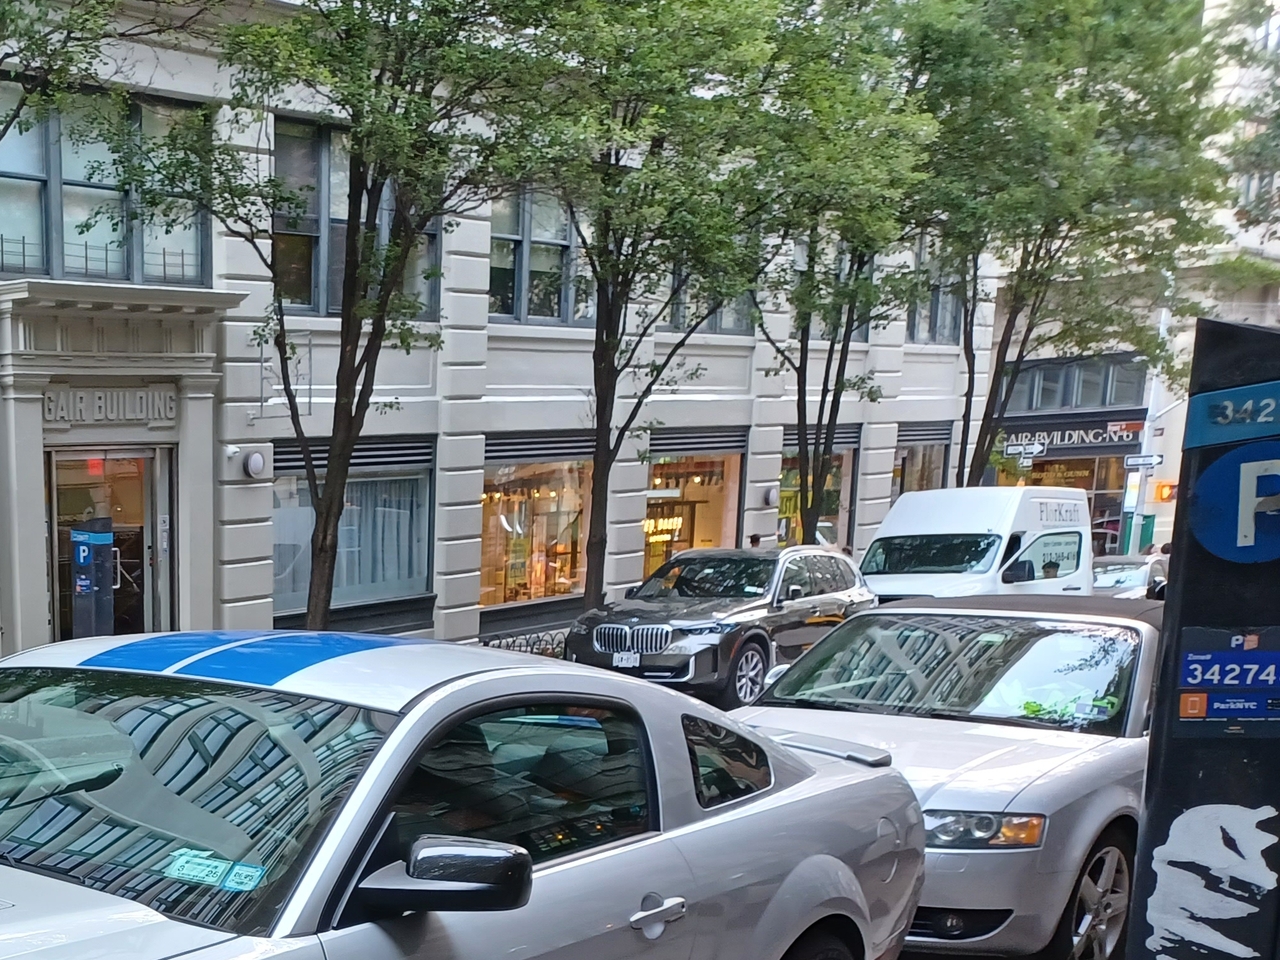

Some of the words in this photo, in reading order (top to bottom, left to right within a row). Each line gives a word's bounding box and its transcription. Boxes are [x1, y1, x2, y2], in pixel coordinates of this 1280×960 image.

[43, 391, 86, 421] GAIR
[93, 391, 177, 420] BUILDING
[1217, 398, 1280, 424] 342
[1187, 664, 1277, 685] 34274
